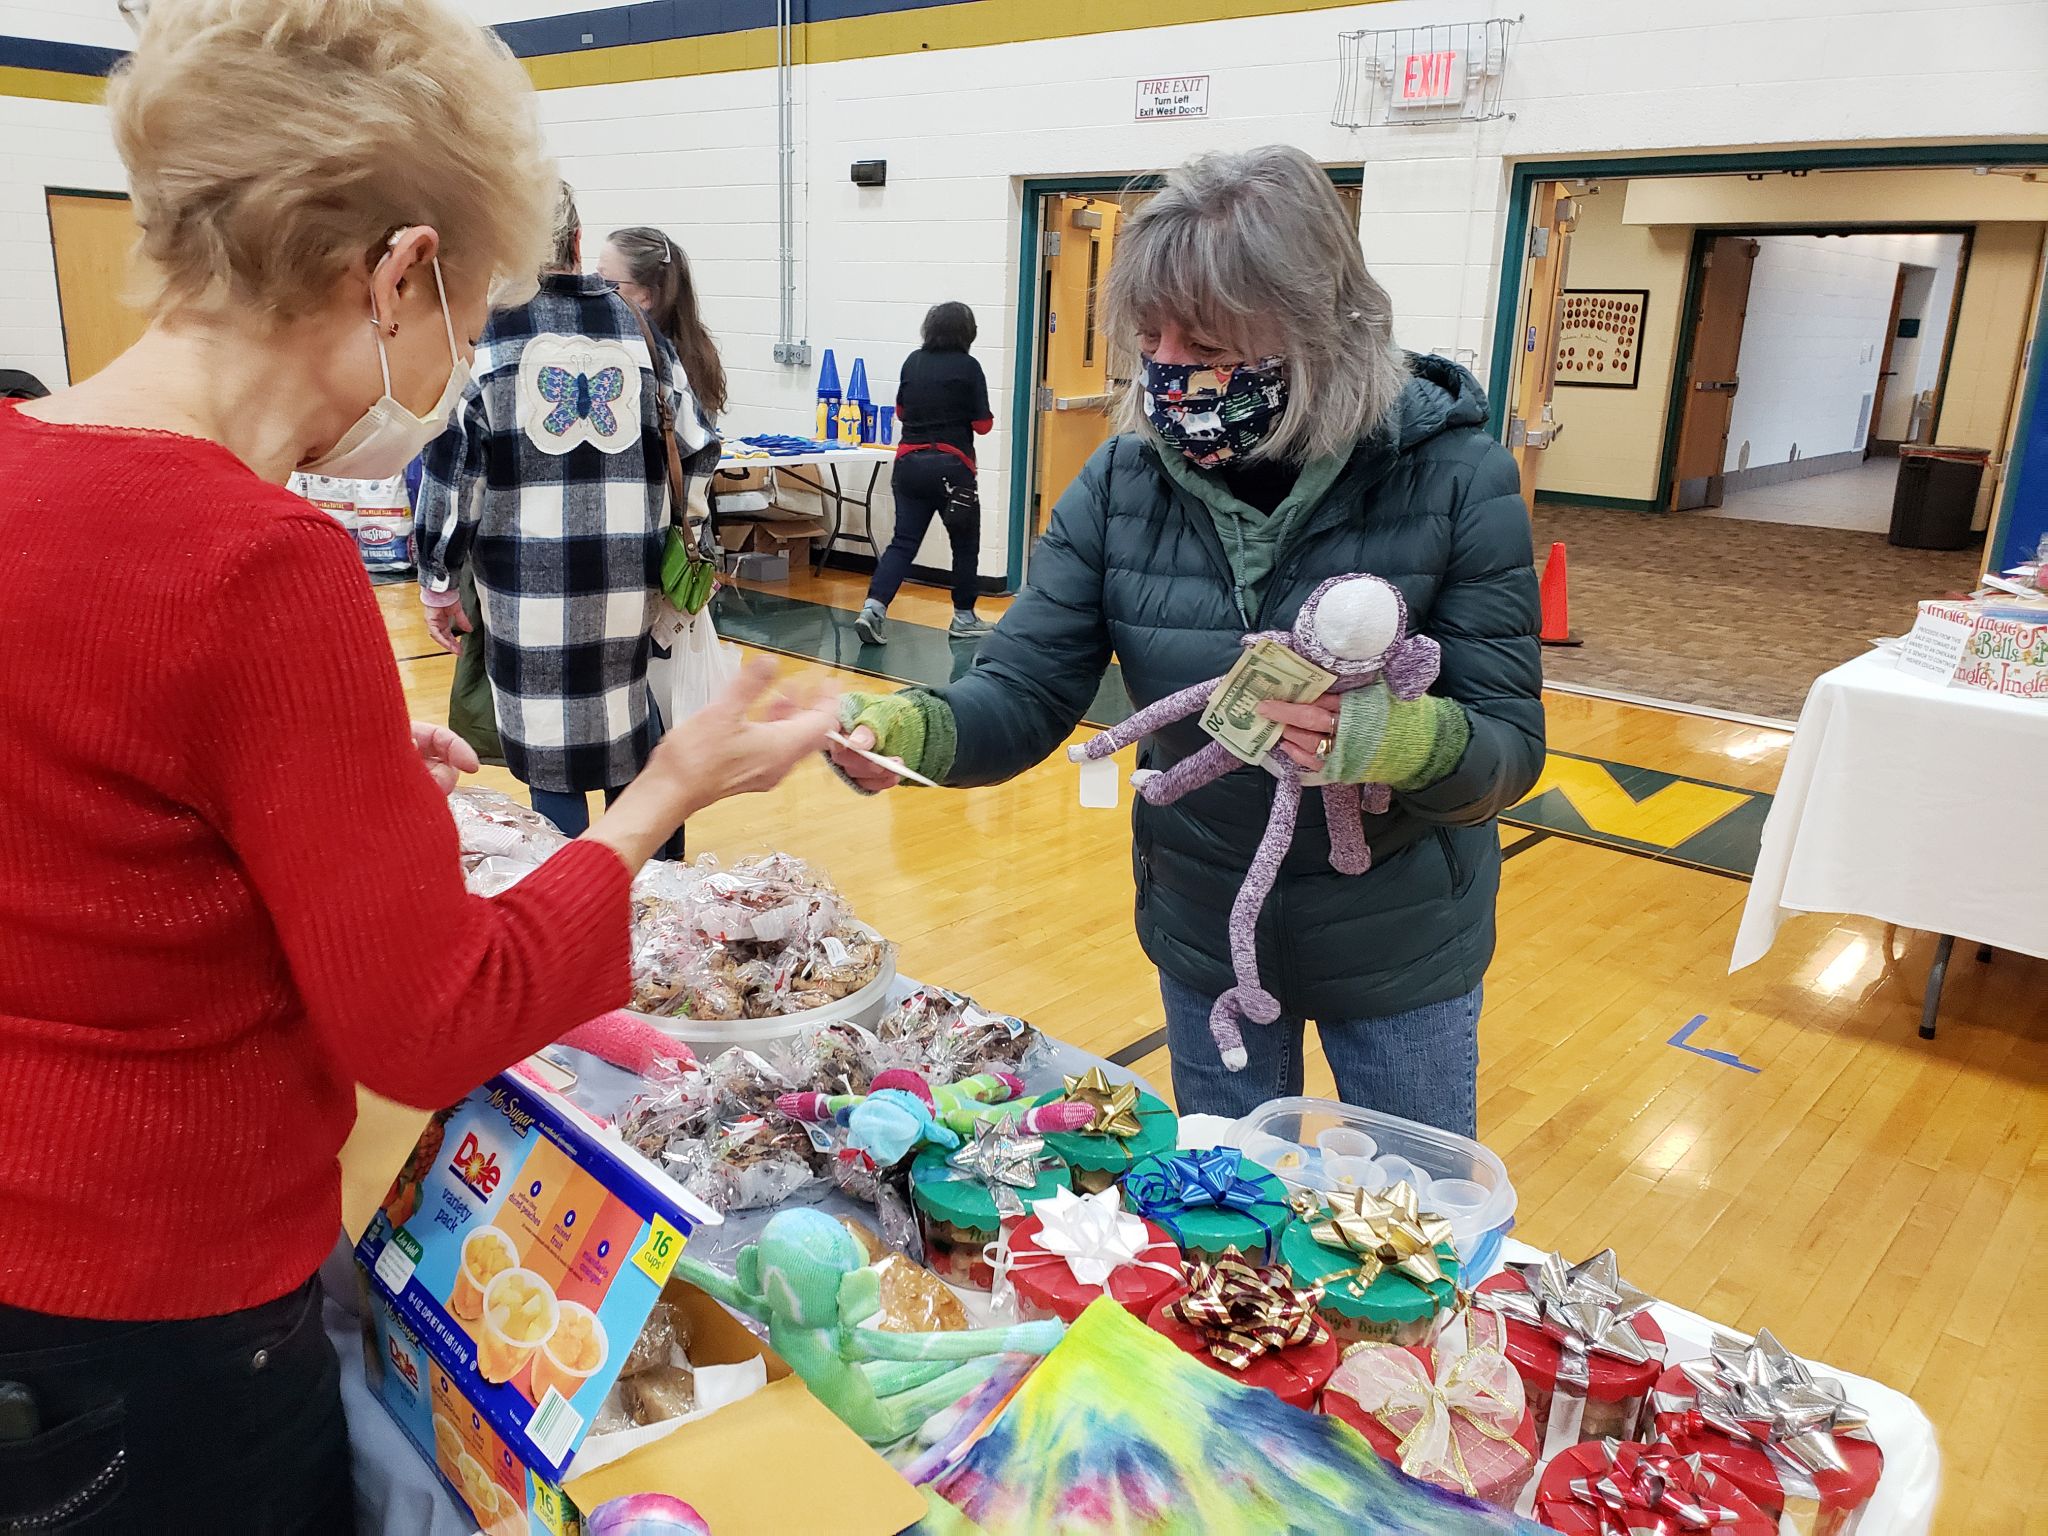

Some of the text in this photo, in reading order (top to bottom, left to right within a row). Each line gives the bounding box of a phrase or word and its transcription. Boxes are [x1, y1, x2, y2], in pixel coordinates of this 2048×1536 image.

[1143, 79, 1203, 95] FIRE EXIT
[1404, 51, 1456, 98] EXIT
[1140, 105, 1203, 116] Exit West Doors
[1154, 95, 1189, 105] Turn Left
[1976, 631, 2020, 662] Bells
[1206, 712, 1224, 733] 20
[486, 1088, 535, 1127] No Sugar
[453, 1131, 501, 1194] Dole
[434, 1208, 458, 1234] pack
[441, 1188, 472, 1224] variety
[653, 1230, 673, 1258] 16
[389, 1334, 418, 1385] Dole
[538, 1486, 554, 1516] 16
